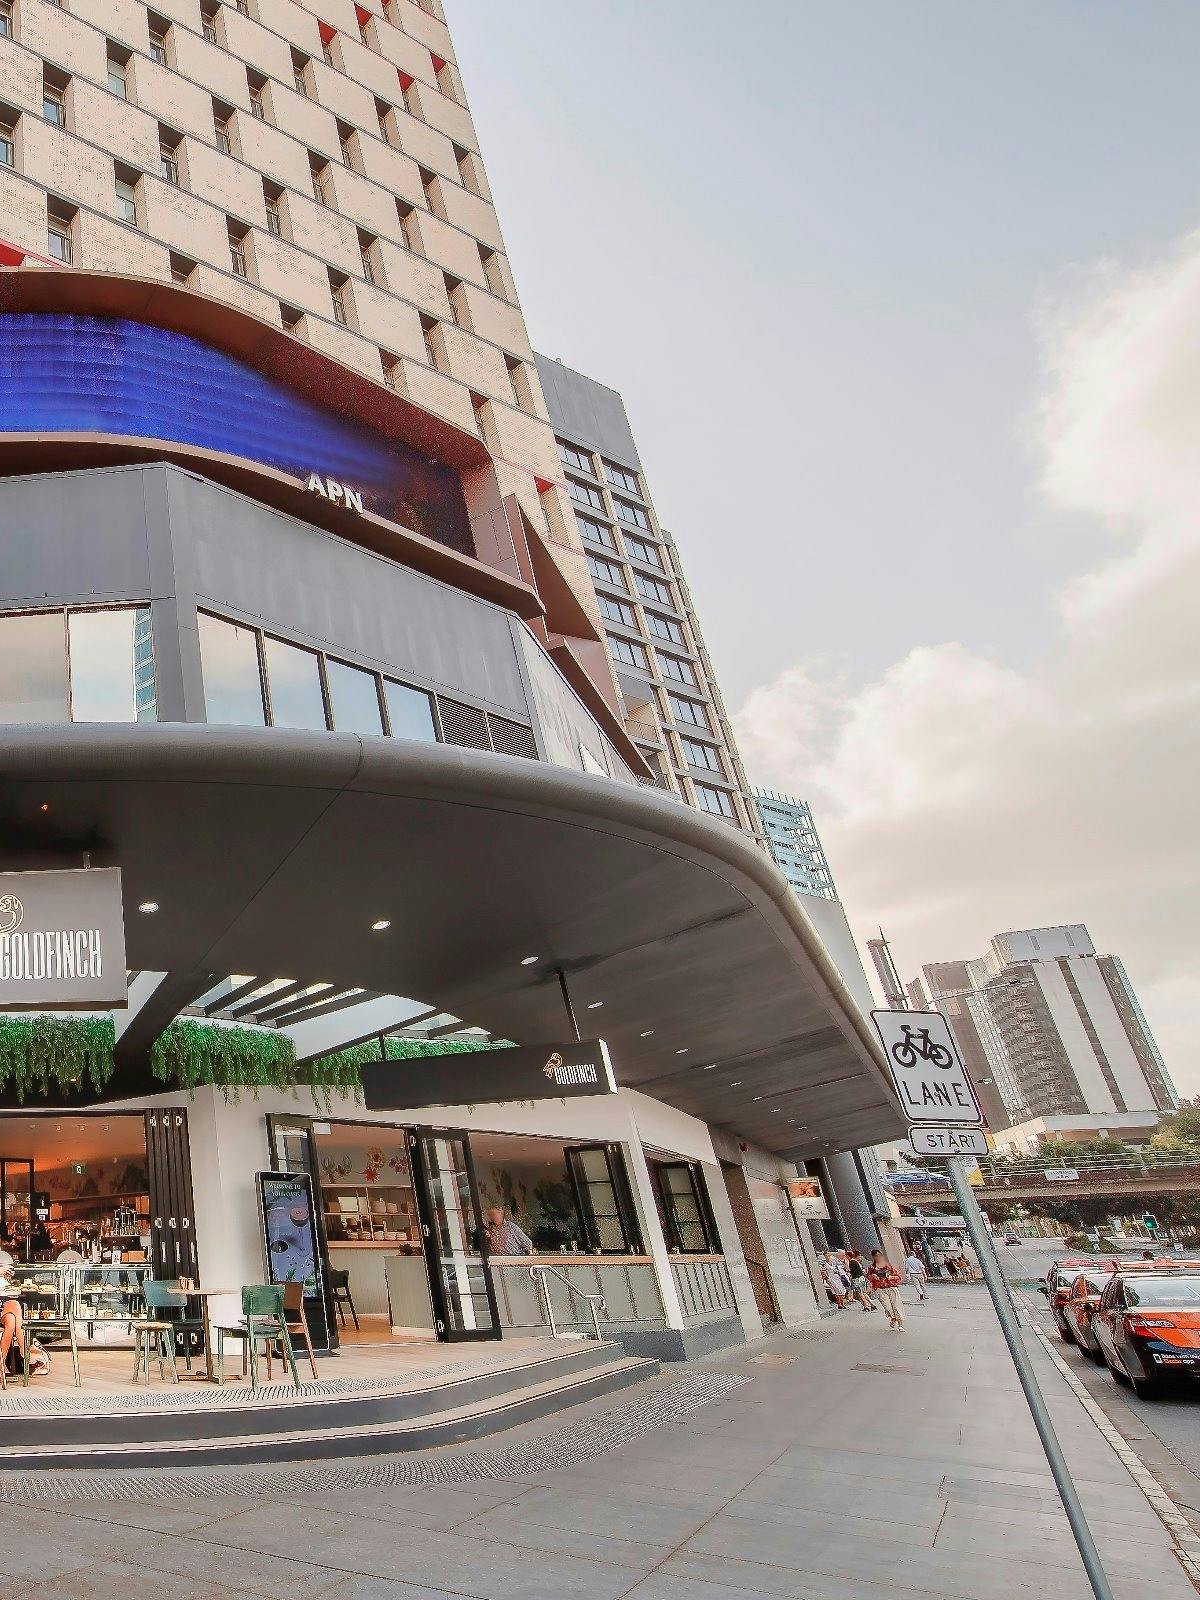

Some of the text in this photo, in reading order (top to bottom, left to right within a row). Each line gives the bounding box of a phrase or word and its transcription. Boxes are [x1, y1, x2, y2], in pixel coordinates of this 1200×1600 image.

[307, 472, 363, 514] APN
[554, 1063, 597, 1085] GOLDFINCH
[902, 1080, 970, 1107] LANE
[926, 1134, 975, 1148] START
